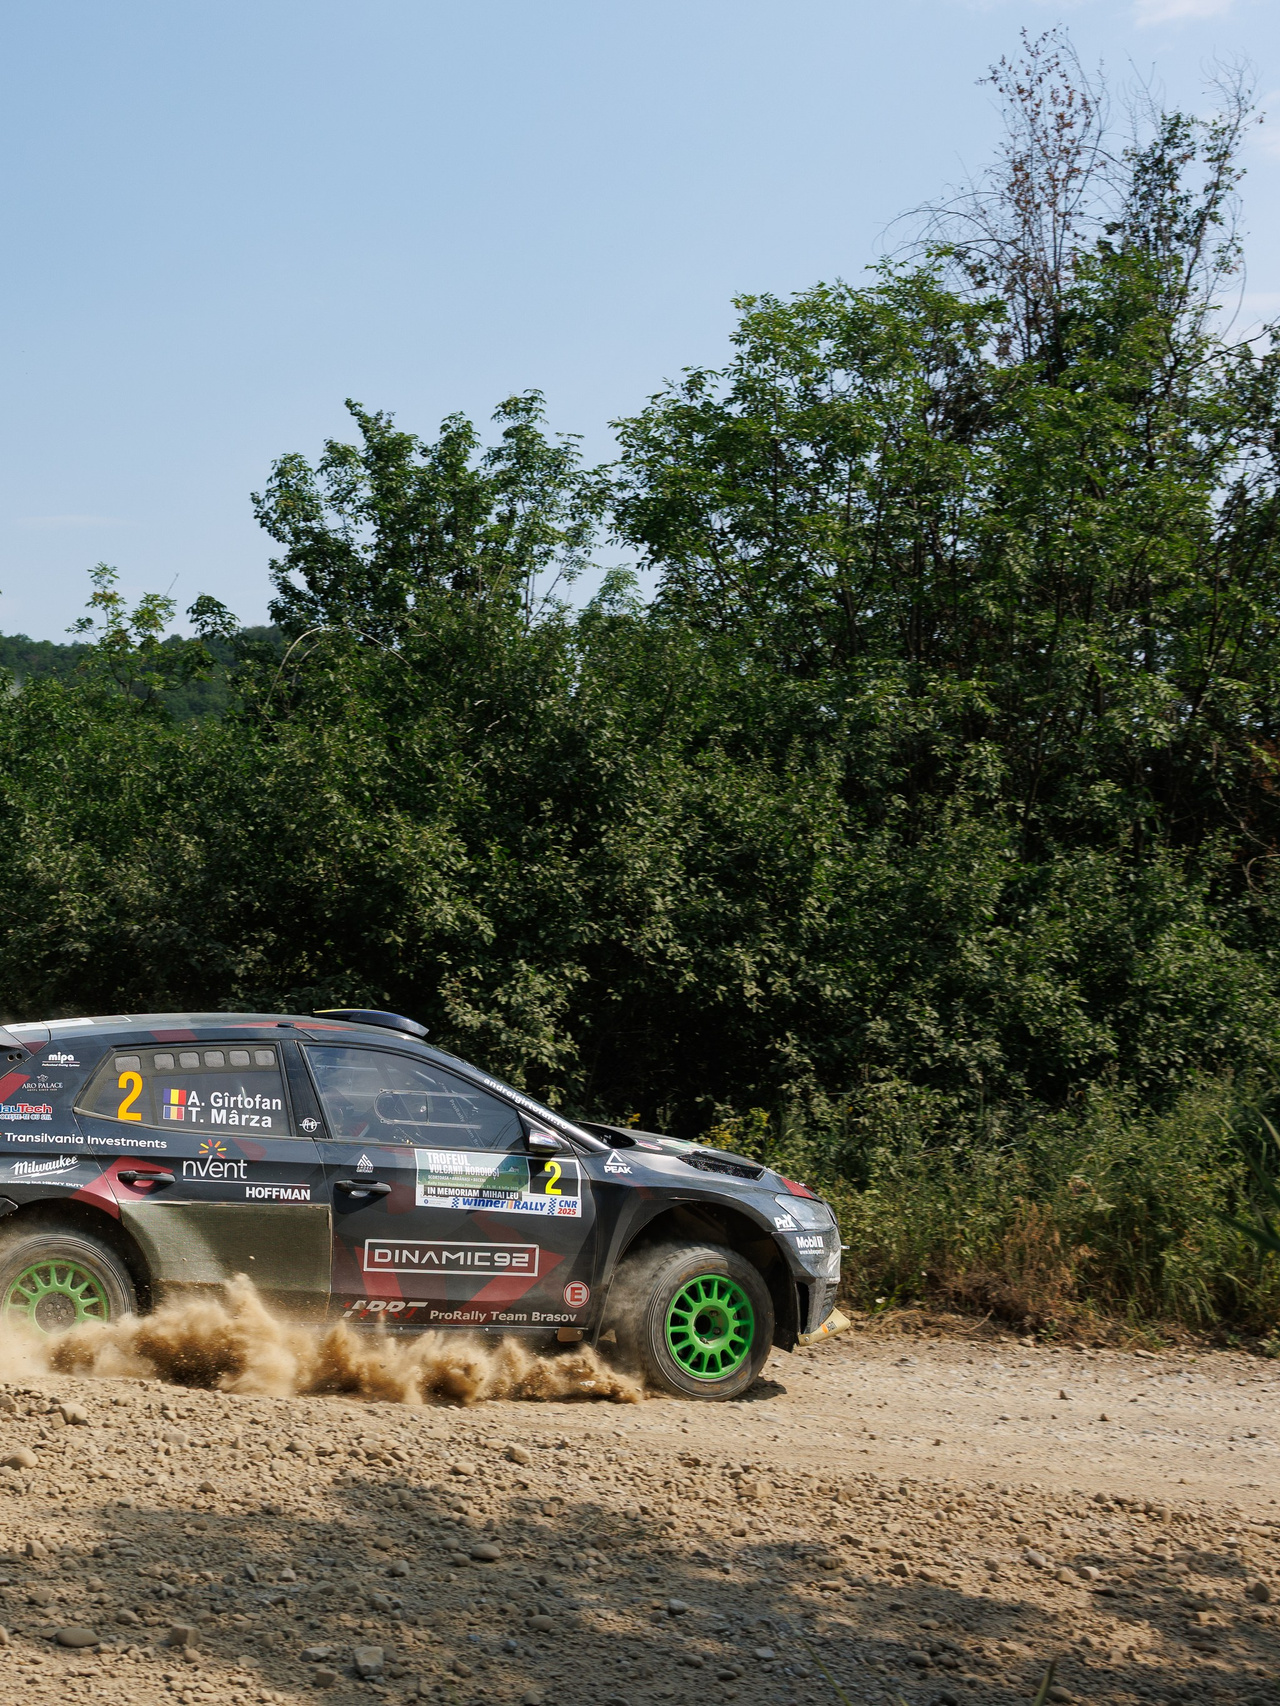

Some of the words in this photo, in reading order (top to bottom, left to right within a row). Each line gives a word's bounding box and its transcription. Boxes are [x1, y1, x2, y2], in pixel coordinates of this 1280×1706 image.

[48, 1051, 75, 1064] mipa
[117, 1071, 143, 1121] 2
[187, 1090, 205, 1107] A.
[210, 1091, 282, 1111] Gîrtofan
[188, 1107, 204, 1123] T.
[210, 1108, 272, 1128] Mârza
[4, 1132, 84, 1145] Transilvania
[87, 1135, 168, 1149] Investments
[10, 1154, 79, 1176] Milwaukee
[426, 1152, 470, 1166] TROFEUL
[182, 1155, 247, 1179] nVent
[603, 1165, 633, 1174] PEAK
[544, 1161, 562, 1195] 2
[245, 1186, 311, 1200] HOFFMAN
[427, 1186, 436, 1195] IN
[437, 1187, 480, 1197] MEMORIAM
[482, 1190, 505, 1199] MIHAI
[506, 1192, 519, 1200] LEU
[513, 1200, 547, 1212] RALLY
[557, 1207, 577, 1216] 2025
[558, 1200, 578, 1208] CNR
[374, 1248, 529, 1267] DINAMIC92
[570, 1286, 583, 1302] E
[430, 1310, 487, 1322] ProRally
[491, 1311, 527, 1321] Team
[531, 1311, 578, 1322] Brasov
